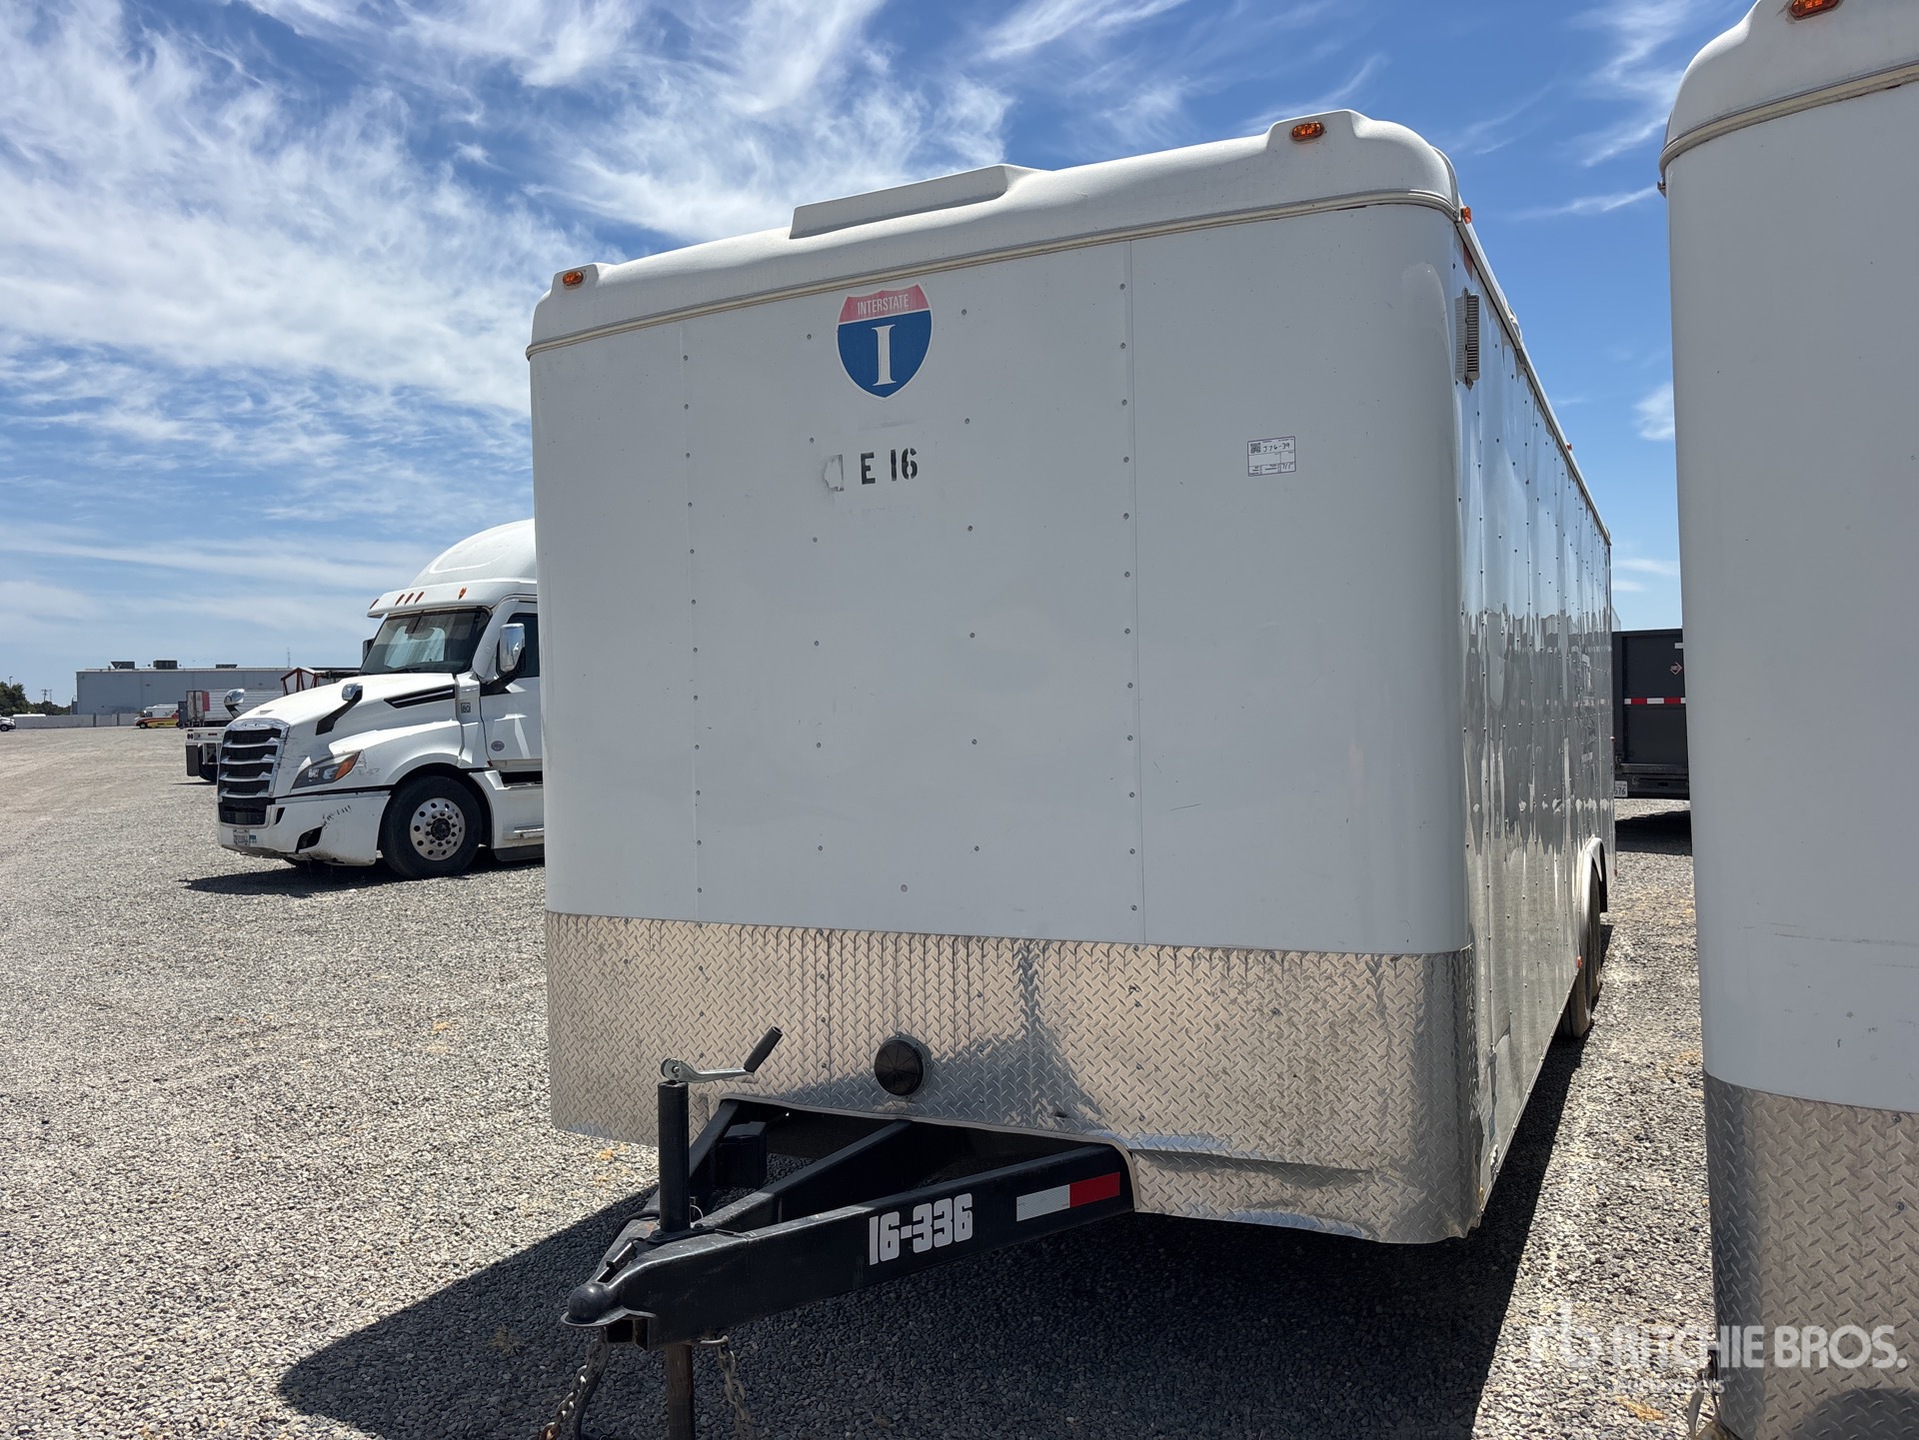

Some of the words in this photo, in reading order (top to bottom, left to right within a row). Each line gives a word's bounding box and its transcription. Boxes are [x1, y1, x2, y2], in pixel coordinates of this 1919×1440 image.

[857, 294, 909, 315] INTERSTATE
[871, 324, 897, 387] I
[860, 452, 876, 485] E
[890, 448, 918, 482] 16
[869, 1193, 973, 1266] 16-336
